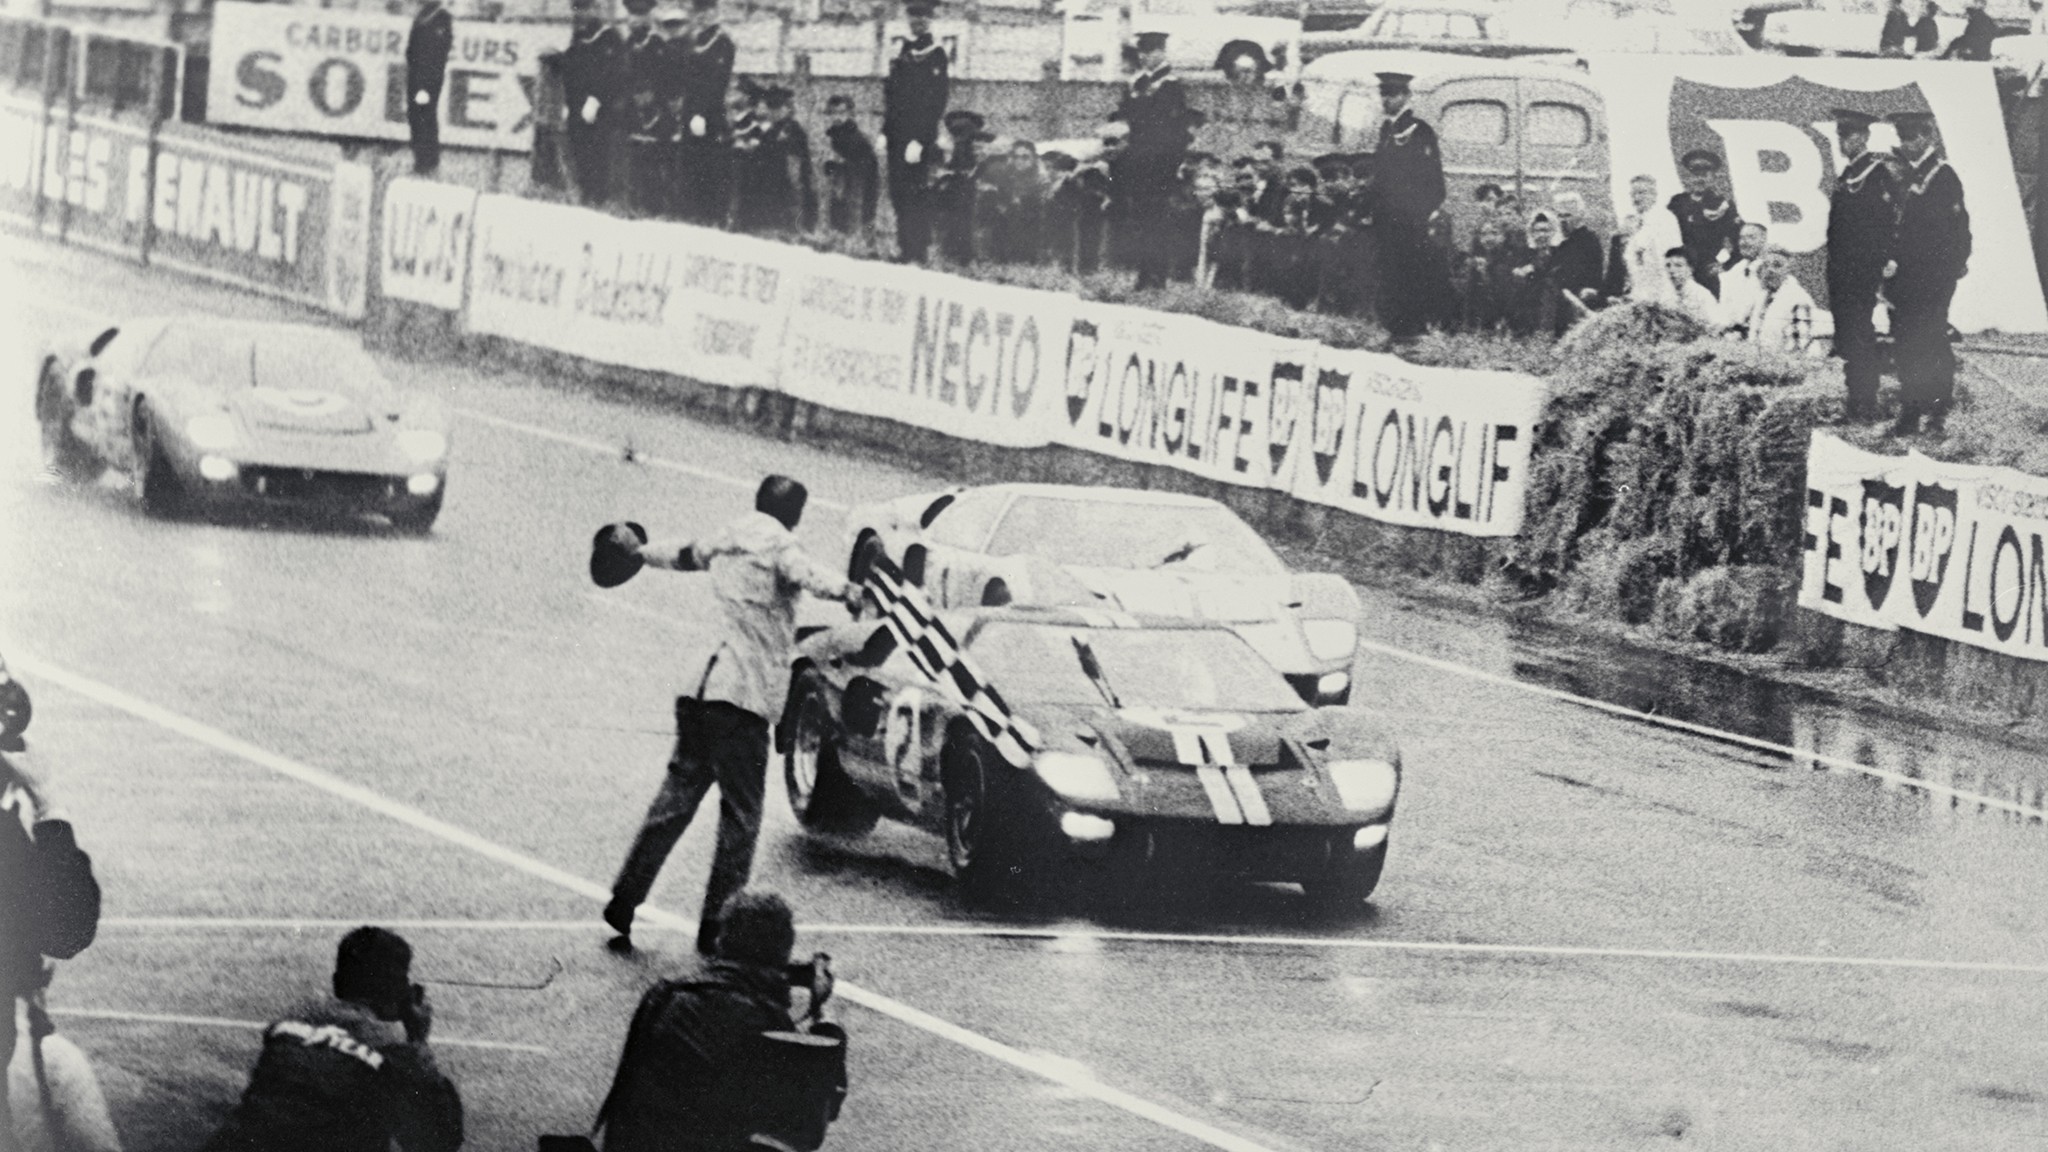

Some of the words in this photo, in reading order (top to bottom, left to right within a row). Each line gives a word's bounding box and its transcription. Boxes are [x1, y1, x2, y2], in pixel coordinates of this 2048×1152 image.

[285, 22, 519, 66] CARBURURS
[909, 295, 1040, 419] NECTO
[1098, 351, 1259, 473] LONGLIFE
[1352, 402, 1518, 523] LONGLIF
